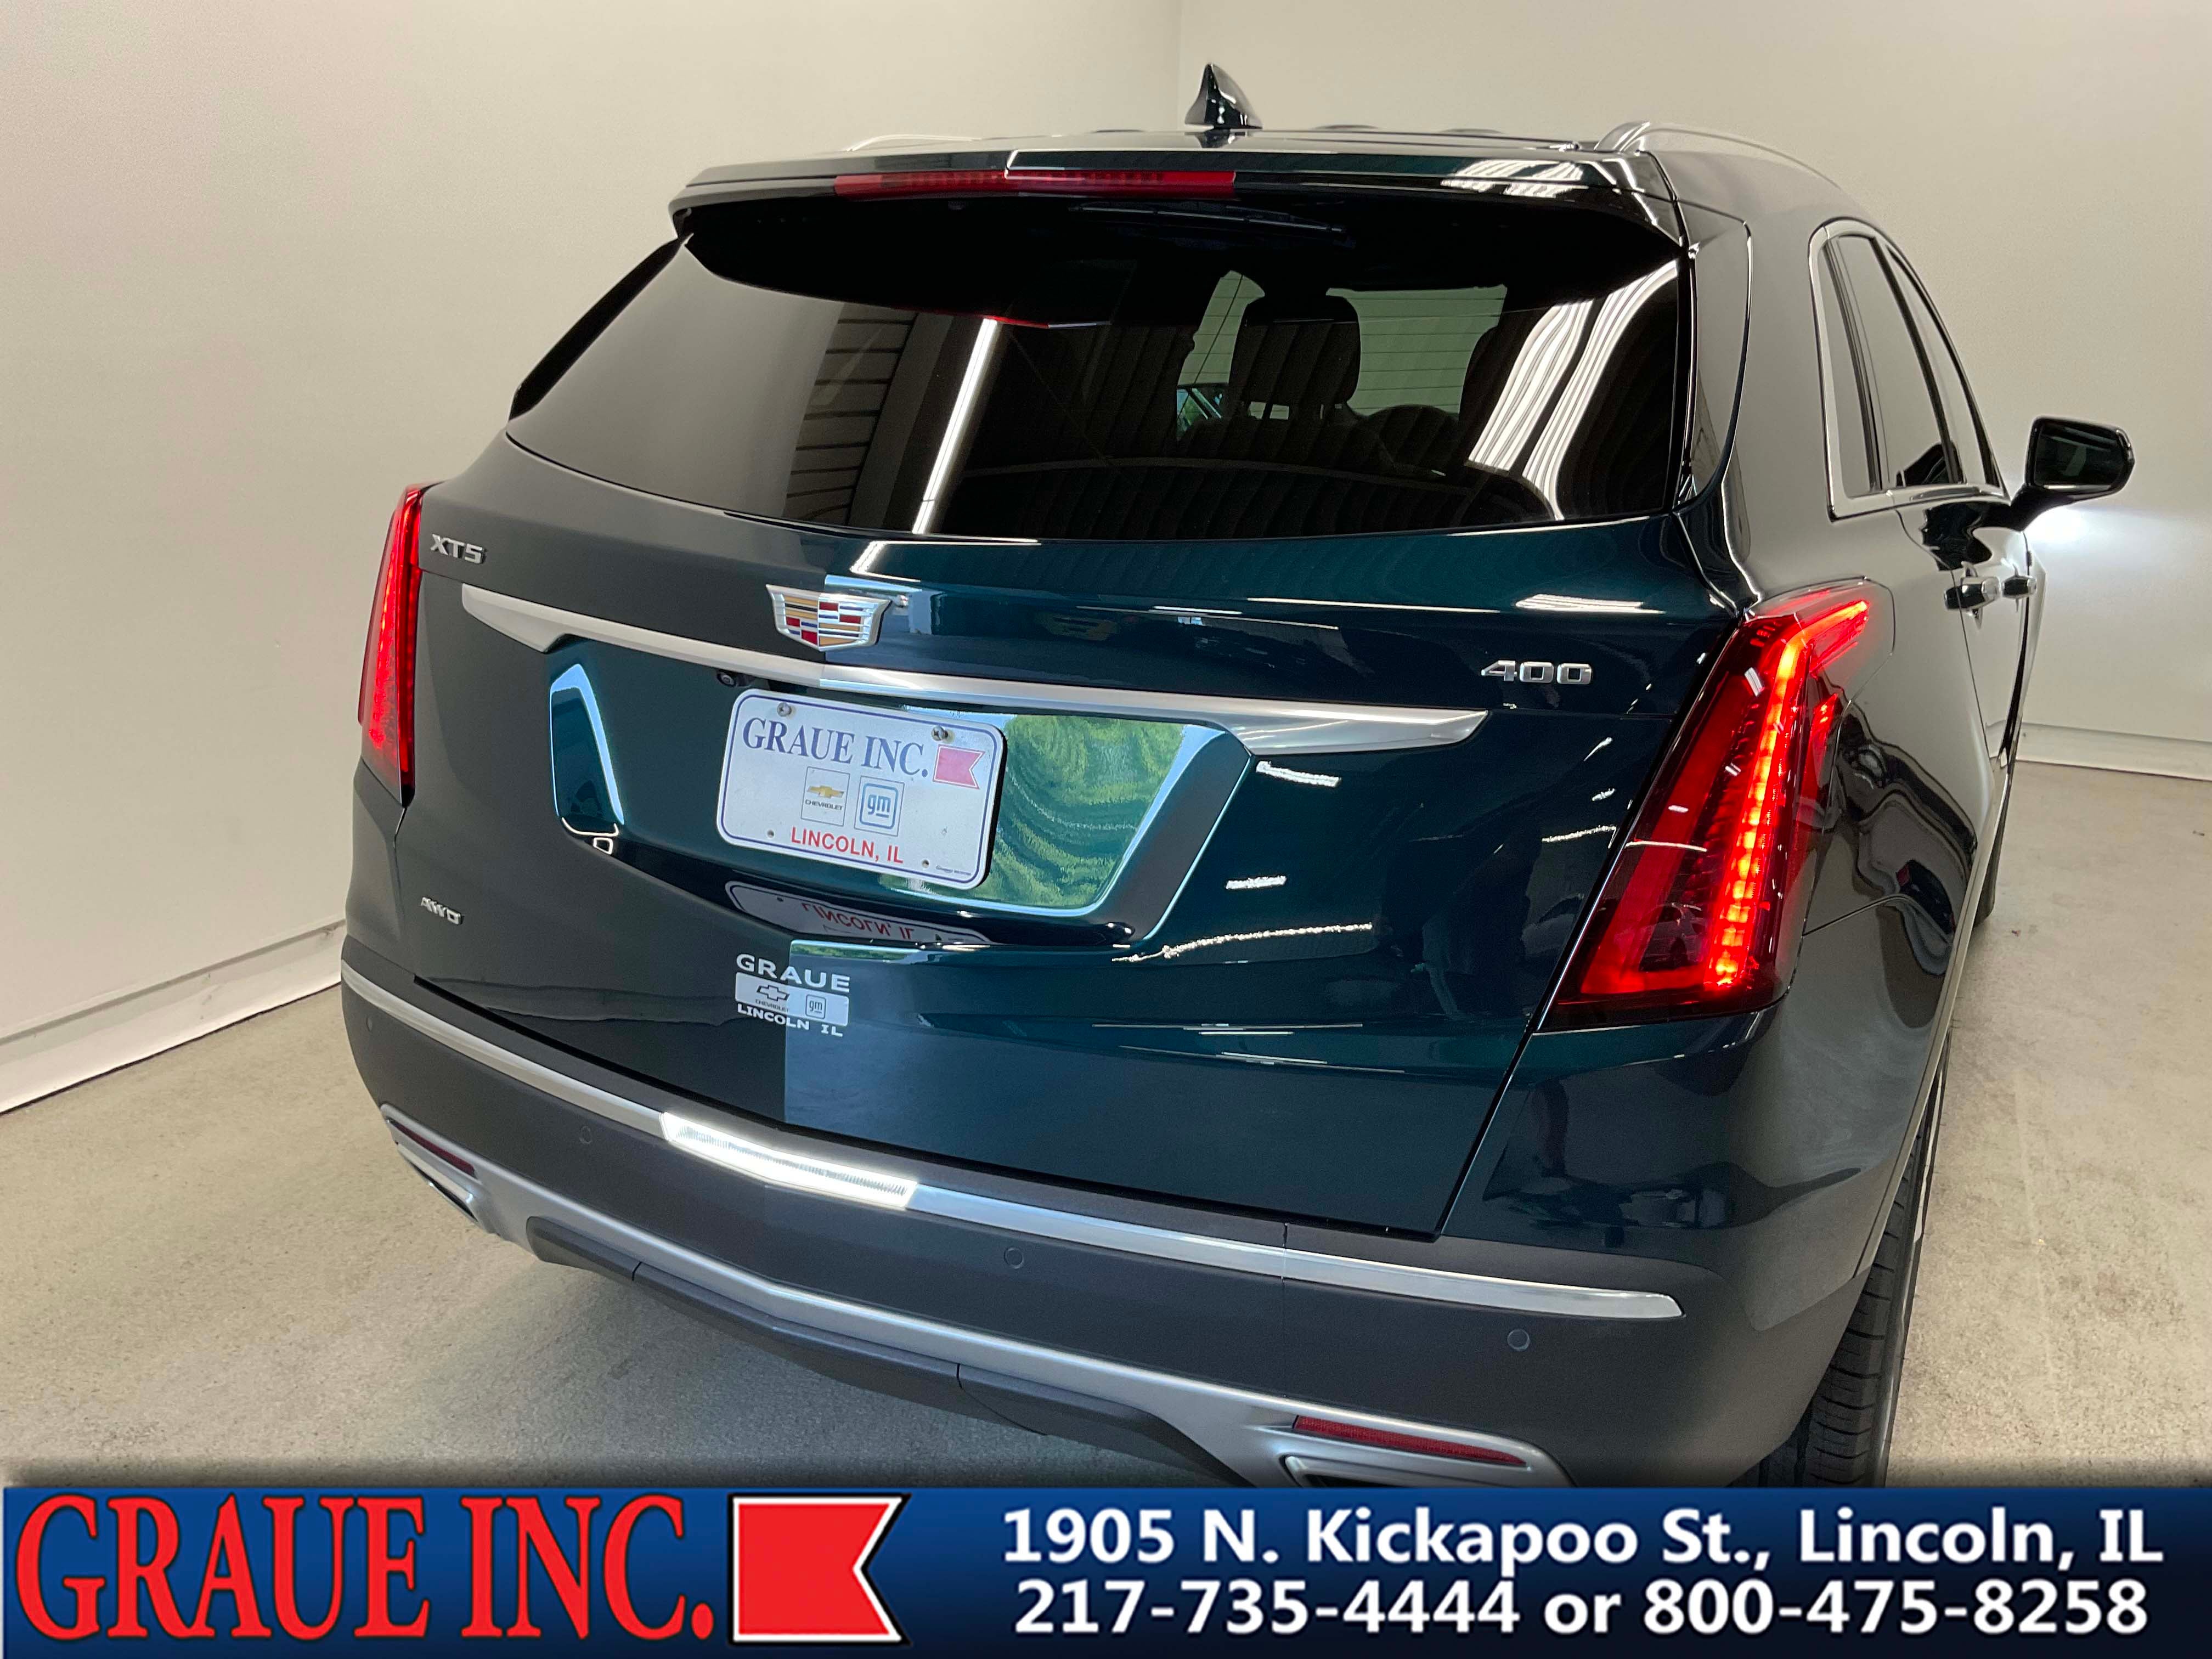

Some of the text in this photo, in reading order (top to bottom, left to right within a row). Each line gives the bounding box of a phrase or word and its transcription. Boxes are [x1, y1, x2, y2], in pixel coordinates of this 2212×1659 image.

[431, 530, 483, 565] XT5
[1481, 660, 1592, 685] 400
[743, 717, 928, 777] GRAUE INC.
[805, 799, 843, 811] CHEVROLET
[791, 827, 904, 864] LINCOLN, IL
[736, 953, 850, 992] GRAUE
[737, 1003, 844, 1037] LINCOLN IL
[755, 998, 789, 1013] CHEVROLET
